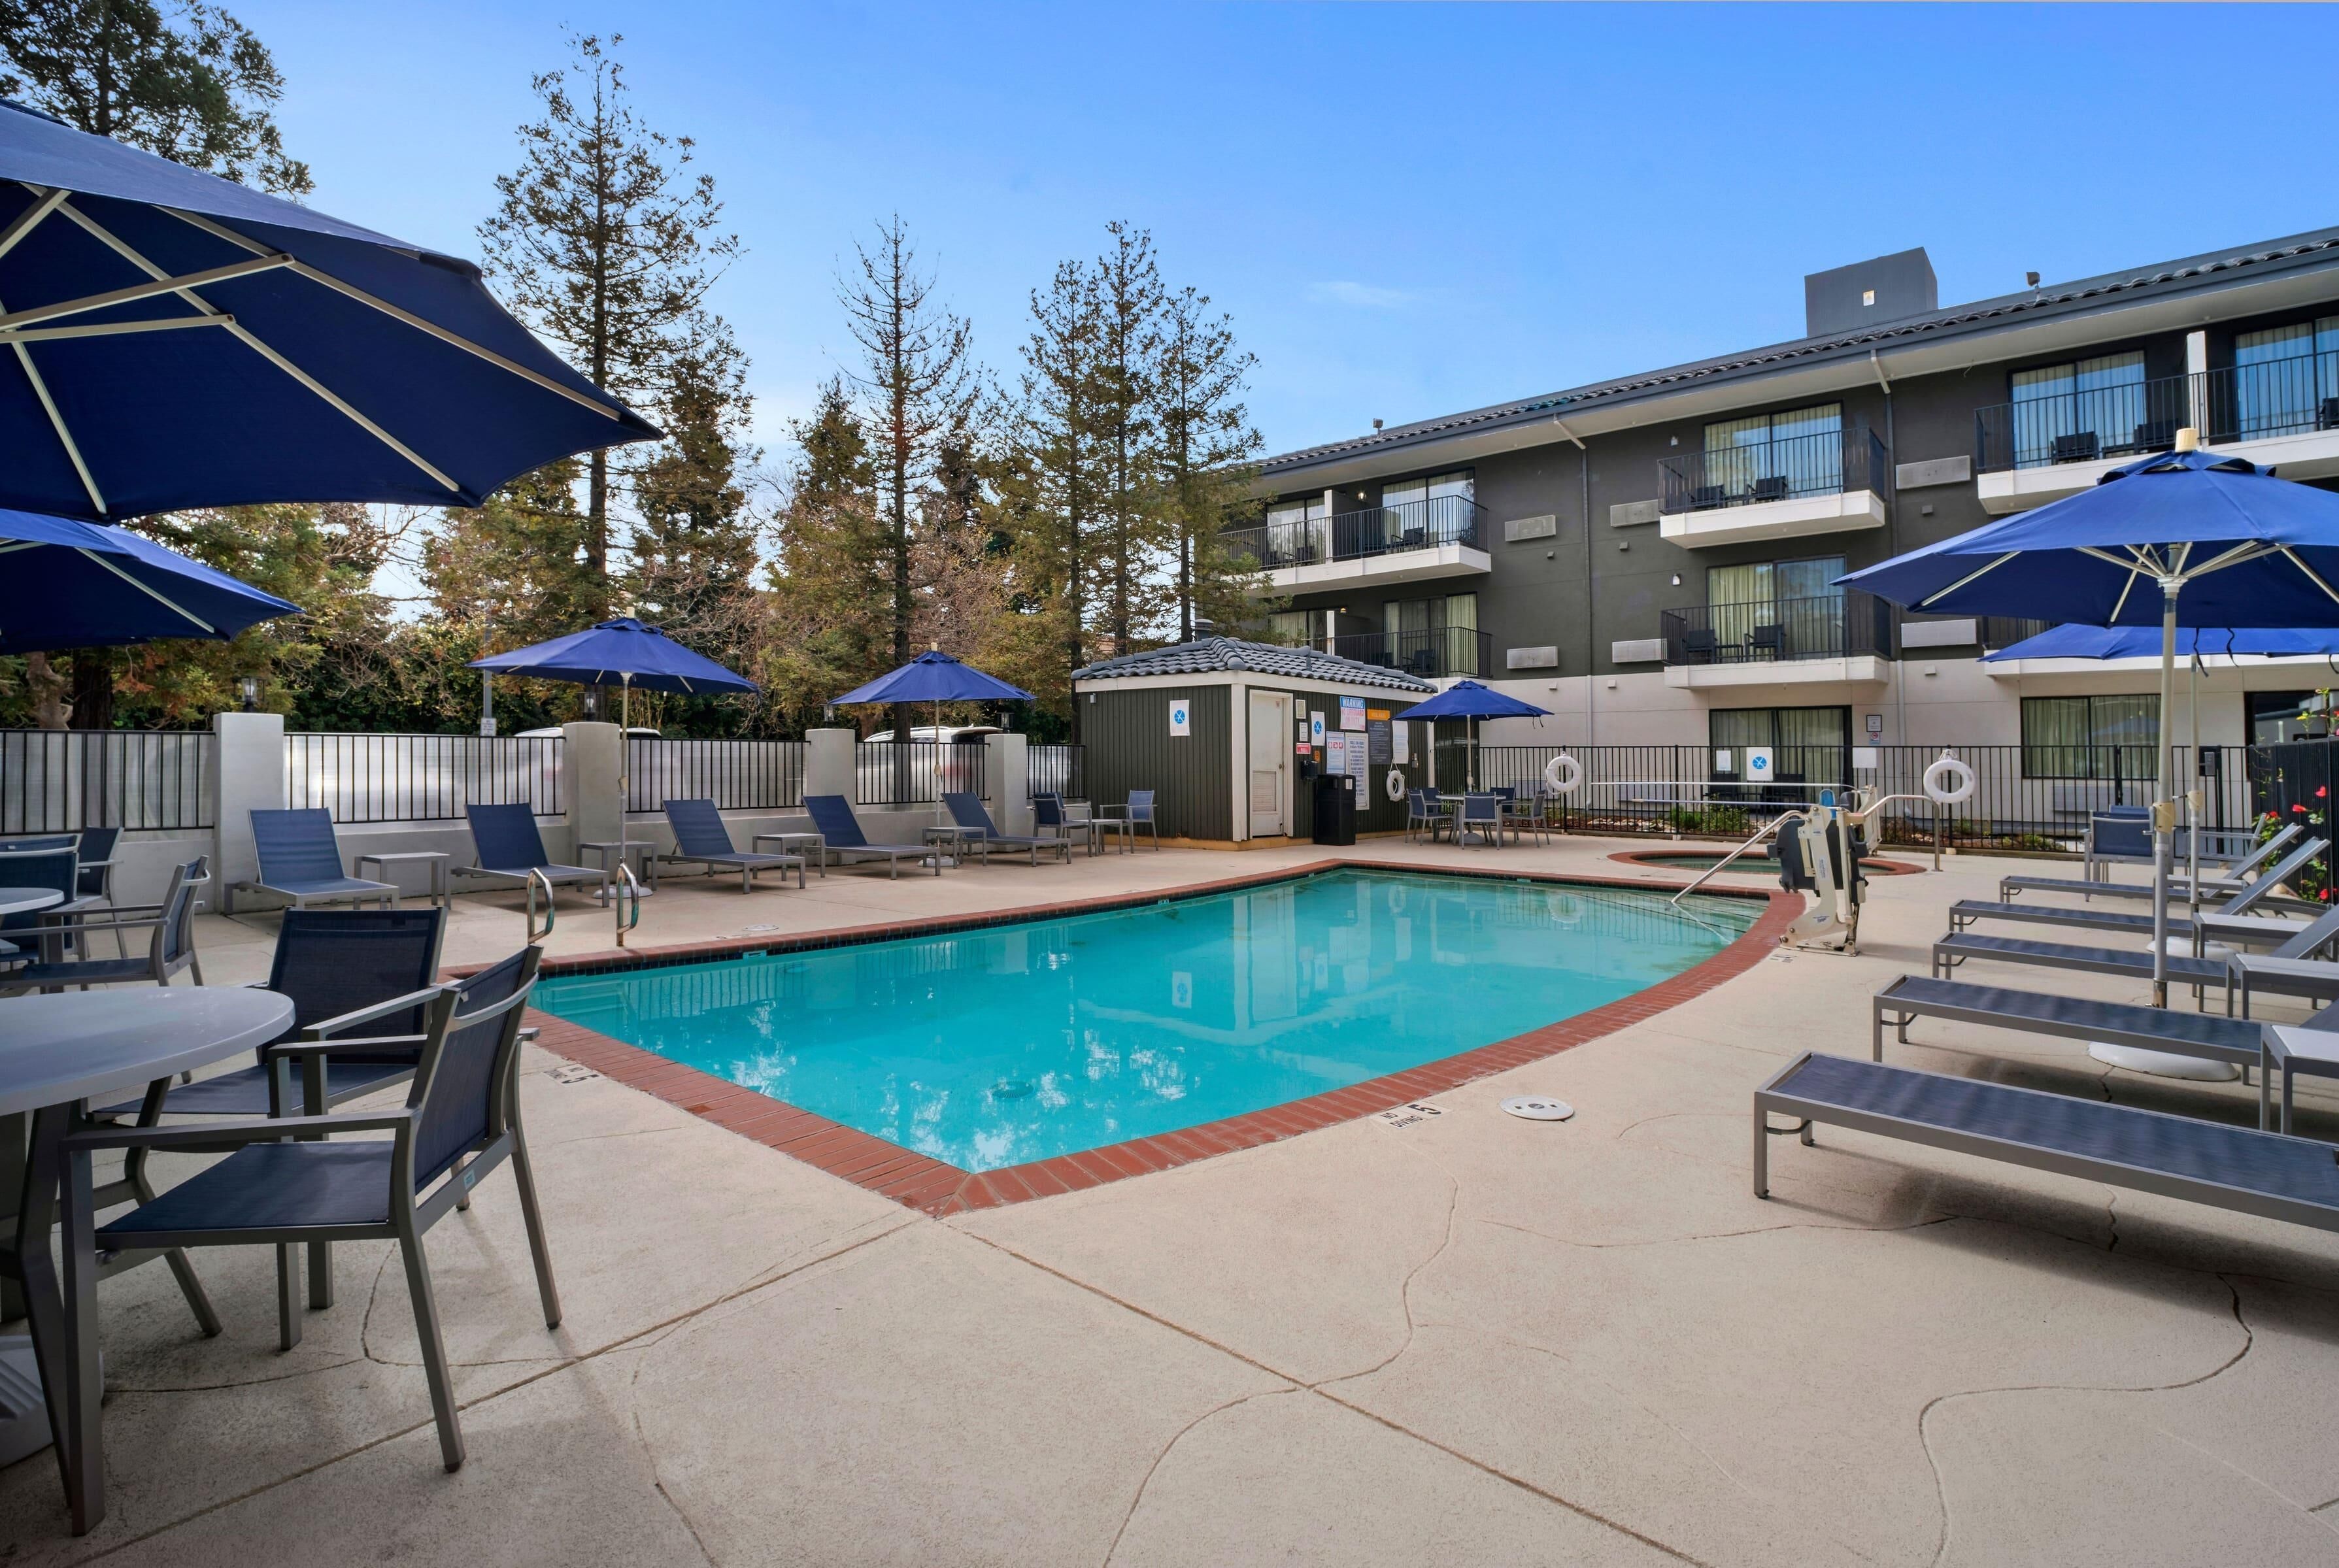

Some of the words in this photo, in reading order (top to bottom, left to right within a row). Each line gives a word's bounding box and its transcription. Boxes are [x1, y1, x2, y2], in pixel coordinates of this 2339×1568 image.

[1342, 697, 1364, 709] WARNING
[561, 1074, 599, 1084] 5
[1407, 1104, 1441, 1114] 5
[1389, 1116, 1423, 1127] DIVING
